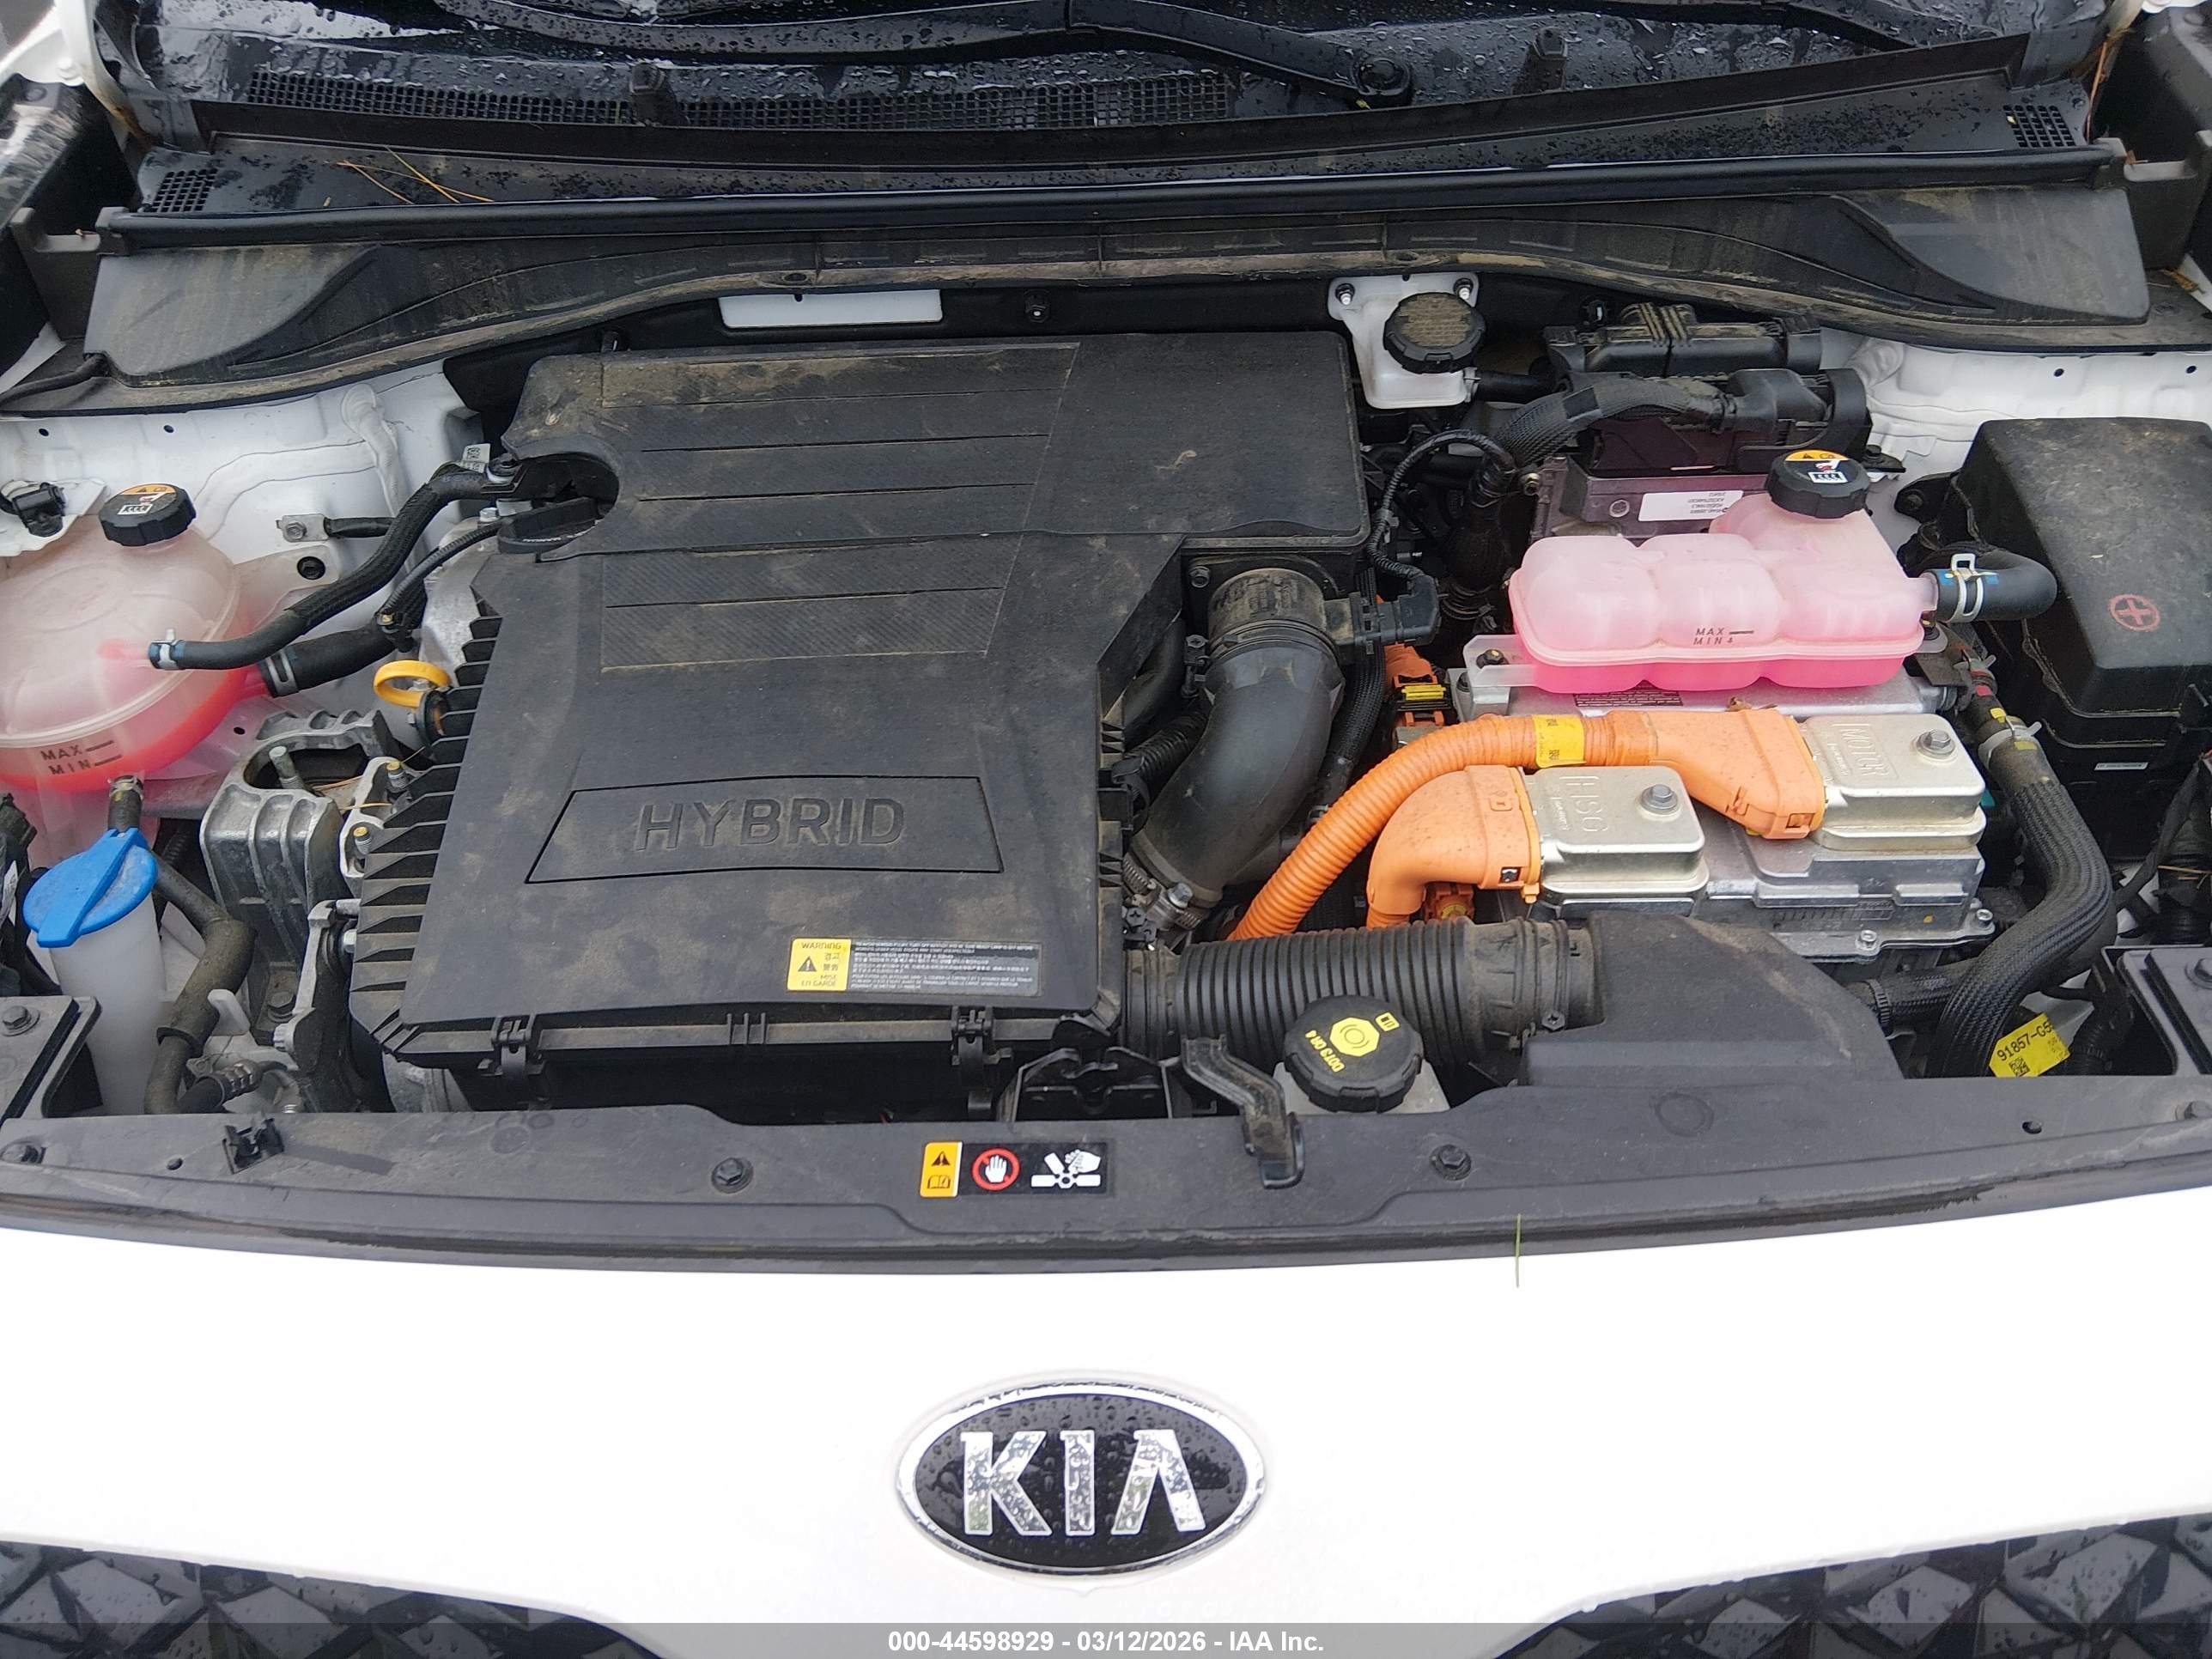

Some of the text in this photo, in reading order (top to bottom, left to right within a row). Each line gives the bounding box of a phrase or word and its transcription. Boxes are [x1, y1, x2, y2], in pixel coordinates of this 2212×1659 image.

[1695, 628, 1725, 636] MAX
[1693, 637, 1723, 646] MIN
[40, 744, 83, 761] MAX
[48, 759, 91, 775] MIN
[635, 797, 904, 851] HYBRID
[1320, 1048, 1346, 1073] DOT3
[960, 1429, 1206, 1536] KIA
